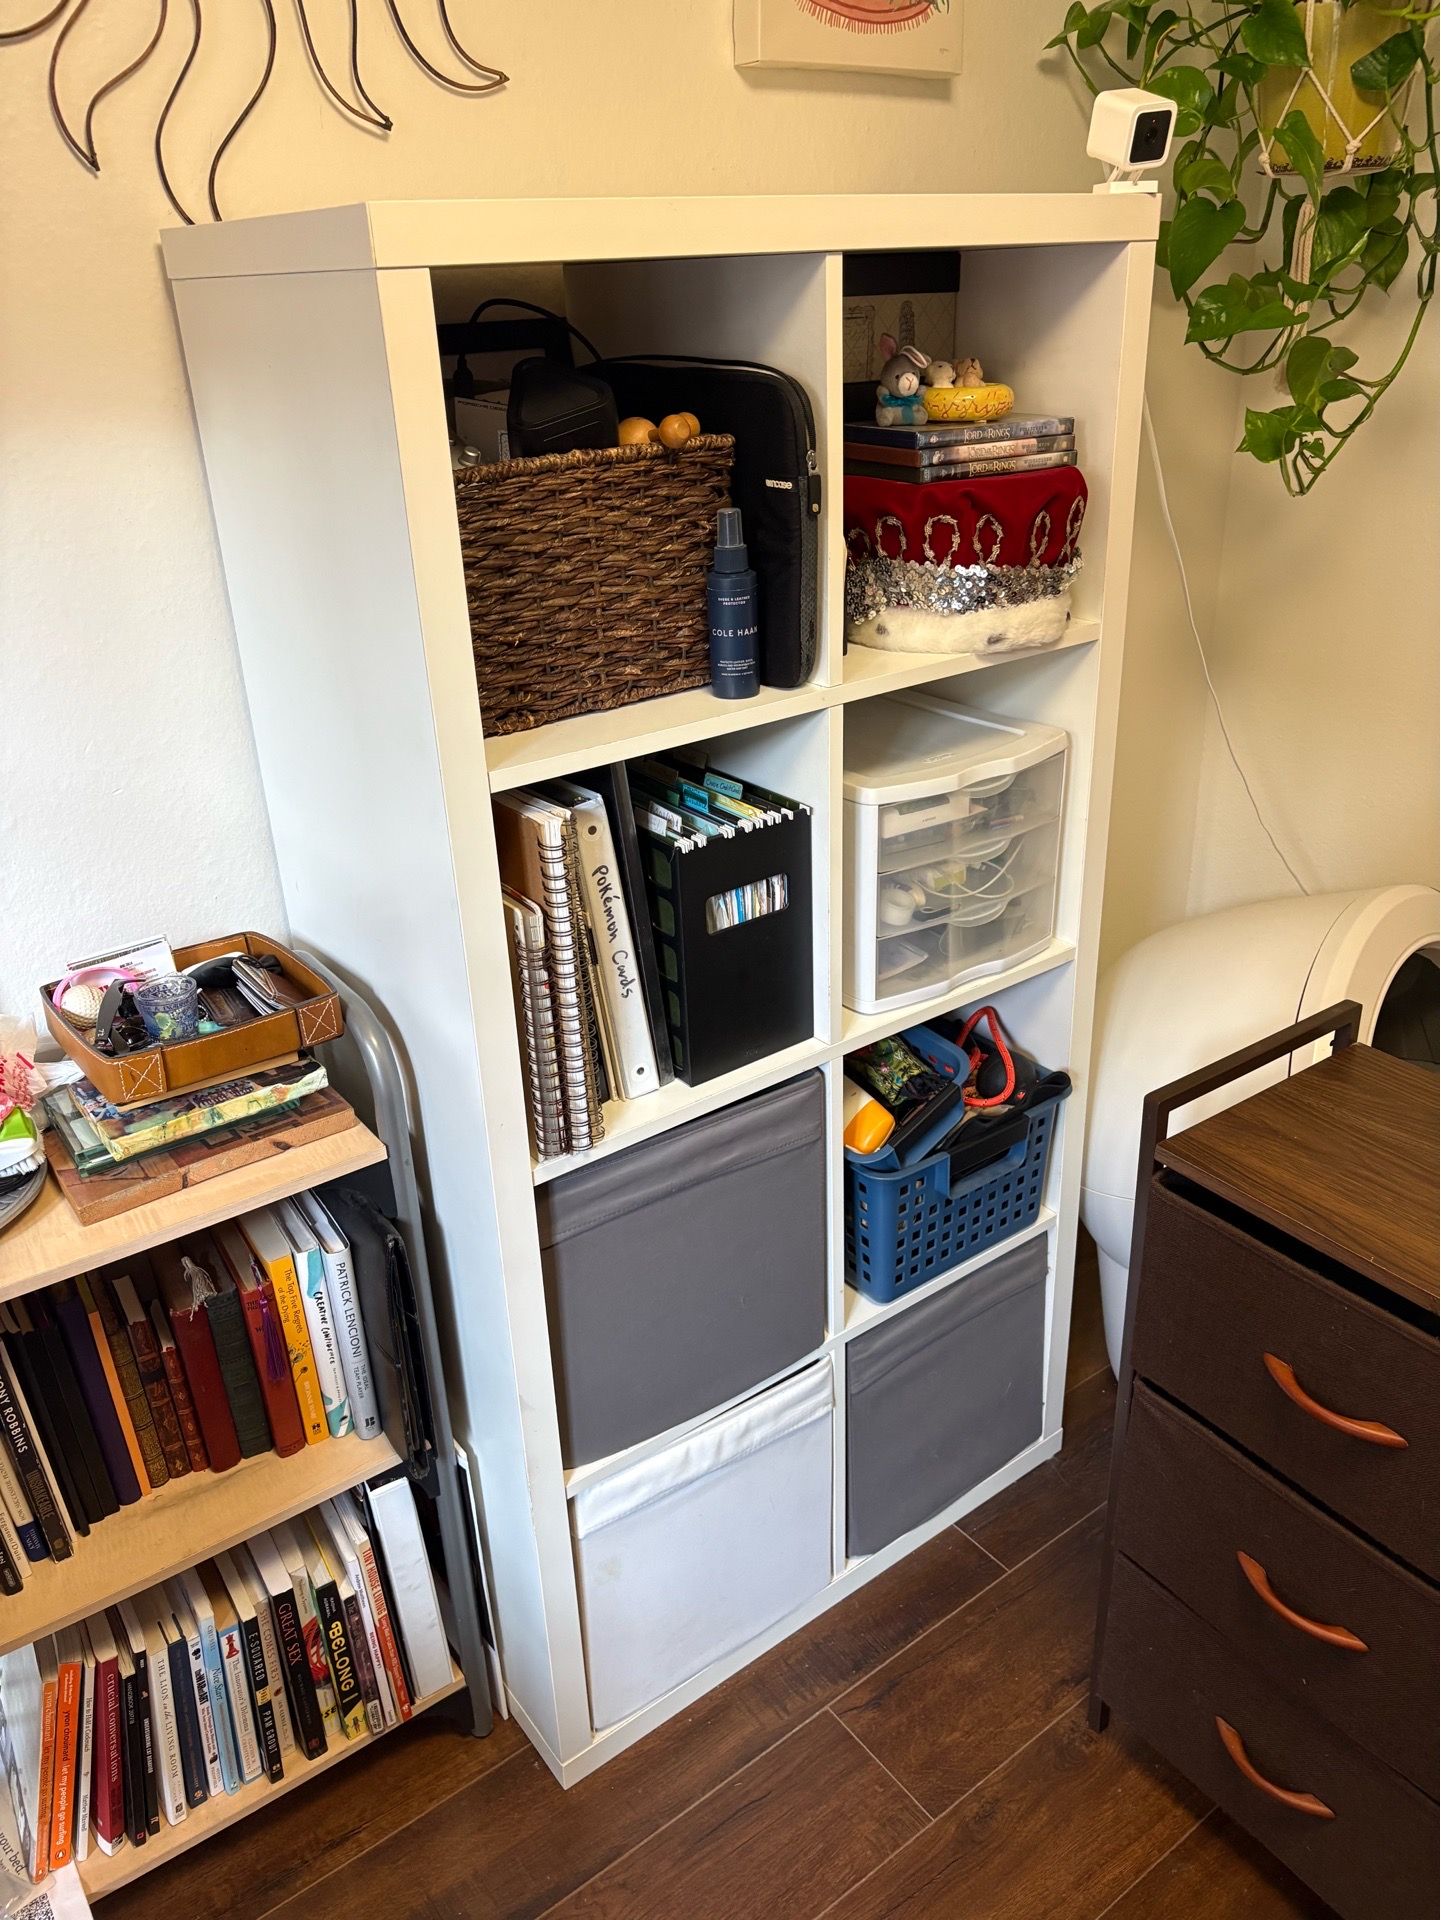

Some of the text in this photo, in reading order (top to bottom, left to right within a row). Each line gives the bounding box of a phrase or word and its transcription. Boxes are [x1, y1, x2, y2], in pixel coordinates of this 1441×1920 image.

[988, 427, 1011, 440] RINGS
[968, 460, 1017, 477] LORD RINGS
[712, 625, 758, 637] COLE HAAN
[592, 864, 636, 999] Pokémon Cards
[281, 1307, 290, 1324] Dying
[284, 1268, 303, 1334] The Top Five Regrets
[313, 1291, 328, 1329] CREATIVE
[336, 1262, 362, 1358] PATRICK LENCIONI
[3, 1406, 28, 1453] ROBBINS
[362, 1547, 388, 1616] TINY HOUSE LIVING
[260, 1609, 280, 1682] SHE COMES FIRST
[278, 1603, 303, 1667] GREAT SEX
[328, 1620, 355, 1692] BELONG
[157, 1659, 165, 1678] THE
[211, 1668, 224, 1701] Nice Start
[159, 1679, 169, 1701] LION
[232, 1658, 240, 1671] The
[239, 1705, 251, 1732] Dilemma
[248, 1632, 277, 1754] E-SQUARED PAM GROUT
[105, 1673, 121, 1783] crucial conversations
[164, 1711, 174, 1720] the
[165, 1721, 176, 1752] LIVING
[56, 1711, 72, 1845] yvon chouinard let my people go surfing
[169, 1753, 179, 1779] ROOM
[8, 1851, 25, 1876] bed.
